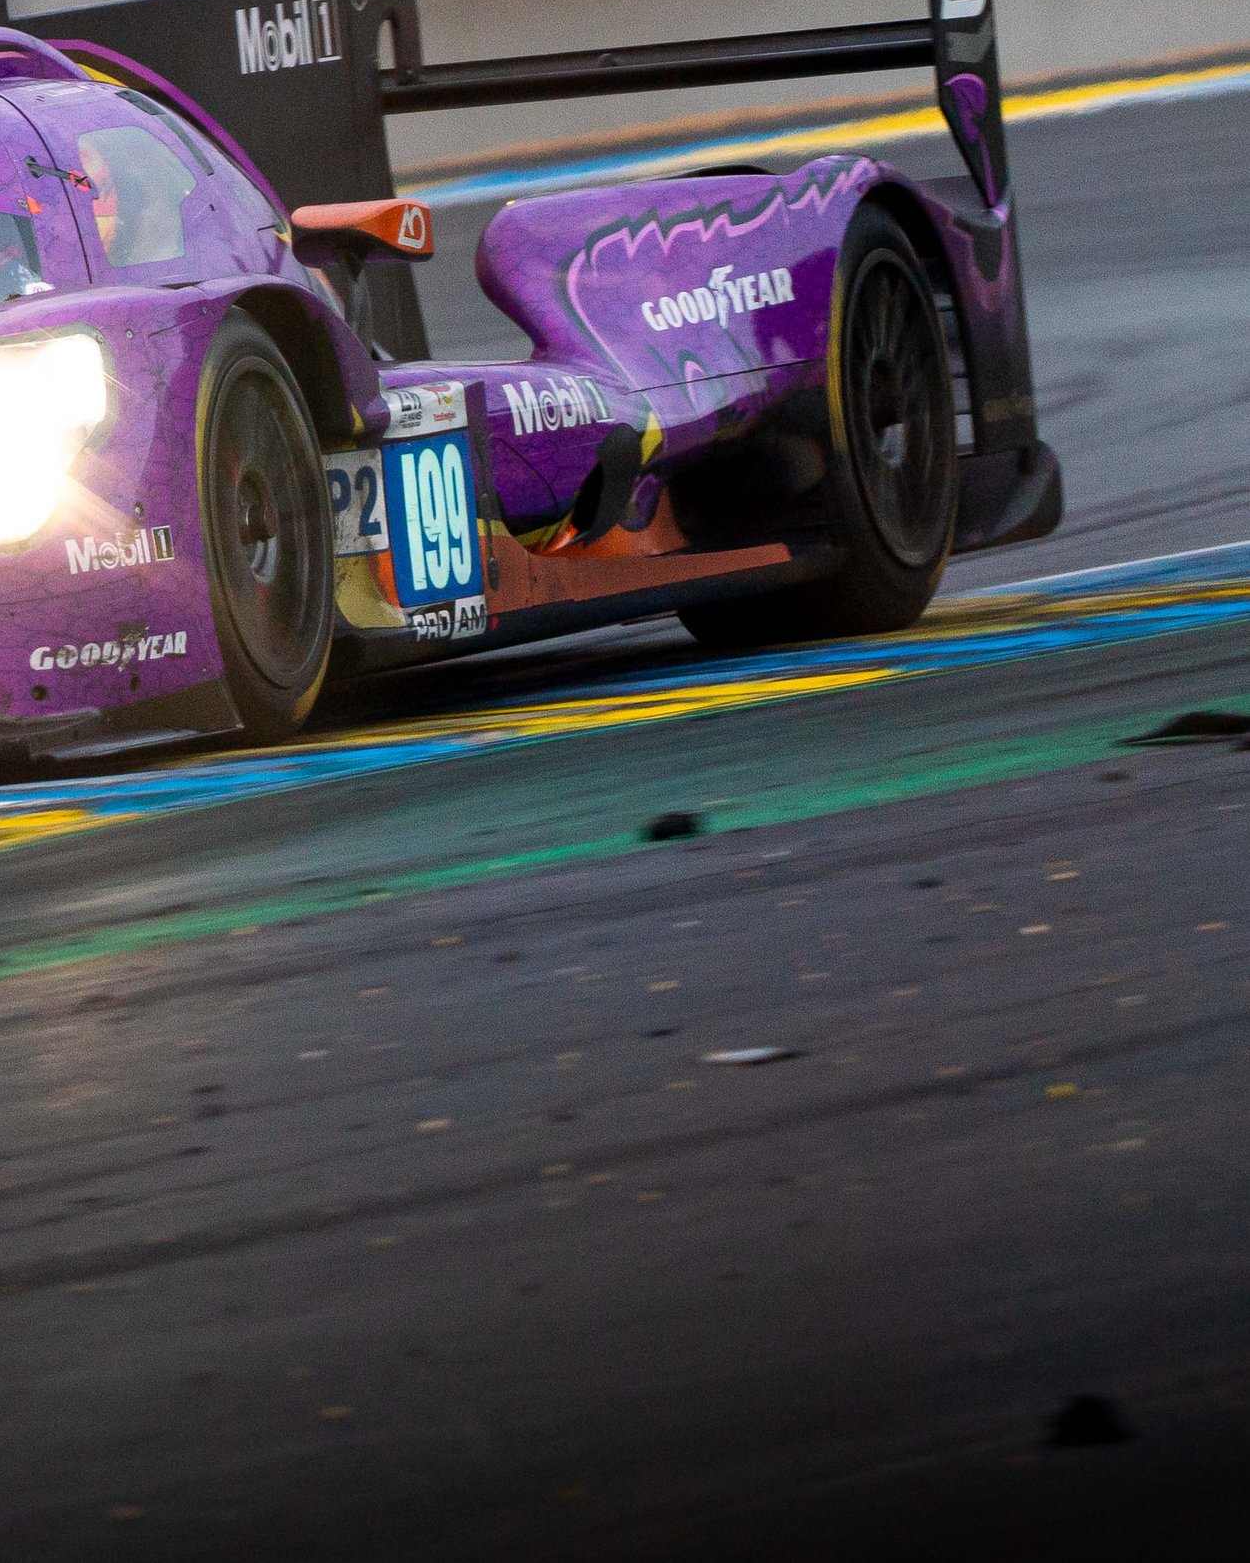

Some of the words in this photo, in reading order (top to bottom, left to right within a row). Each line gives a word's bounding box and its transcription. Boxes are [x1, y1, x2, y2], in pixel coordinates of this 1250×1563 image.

[235, 0, 314, 75] Mobil
[641, 266, 795, 331] GOODYEAR
[502, 377, 590, 436] Mobil
[326, 465, 383, 537] P2
[401, 443, 472, 591] 199
[65, 529, 152, 575] Mobil
[29, 629, 187, 672] GOODYEAR
[412, 609, 451, 641] PRO
[456, 603, 487, 635] AM
